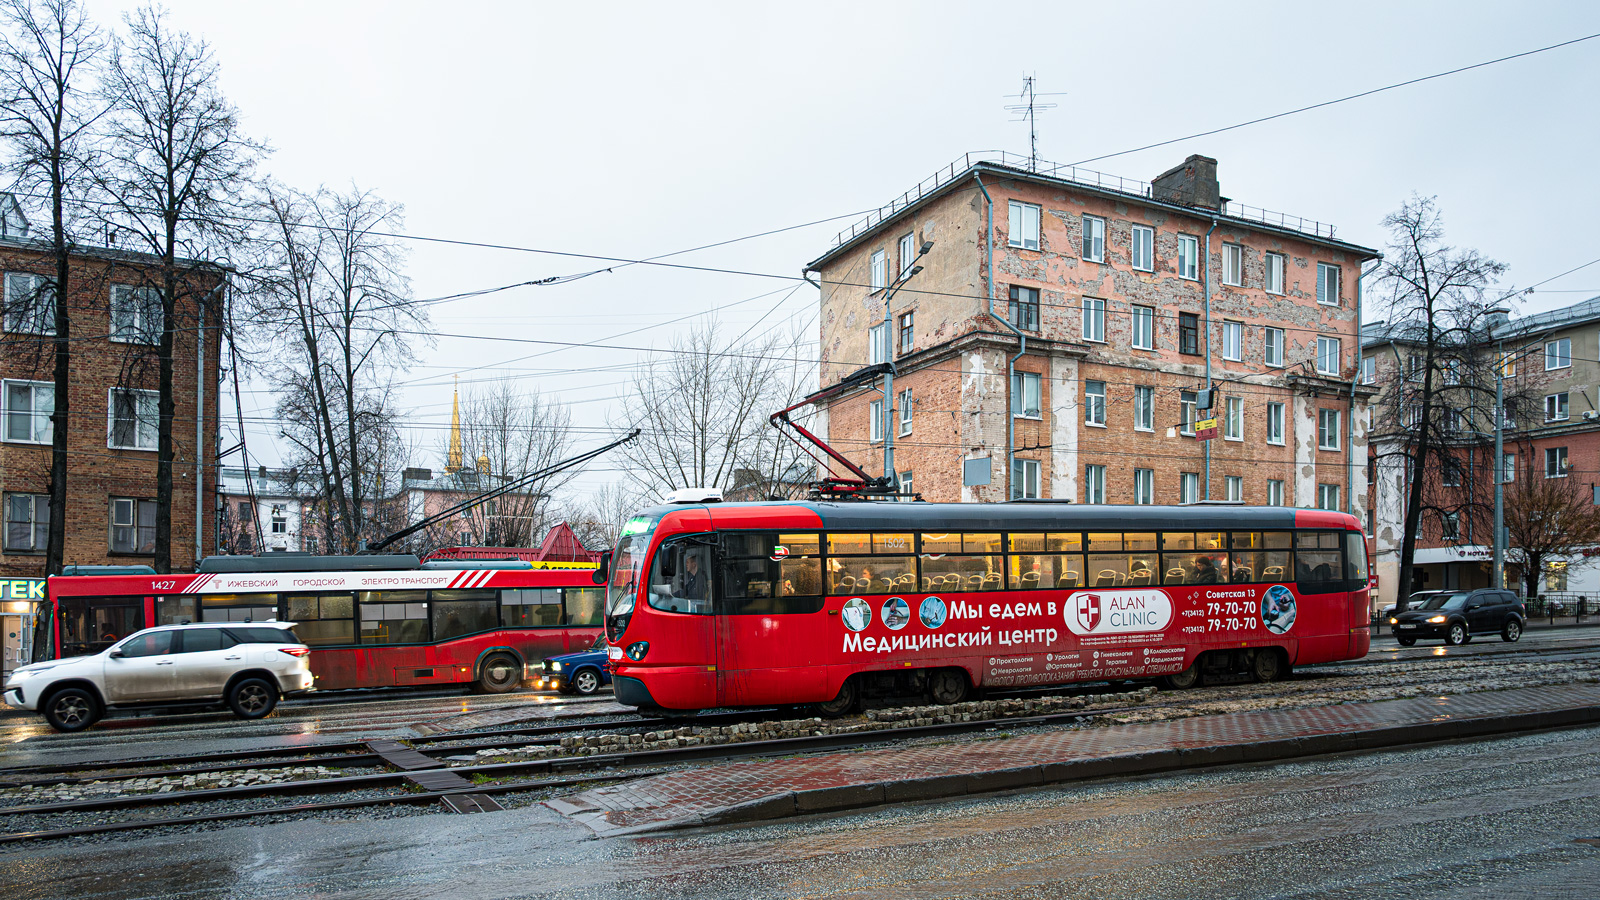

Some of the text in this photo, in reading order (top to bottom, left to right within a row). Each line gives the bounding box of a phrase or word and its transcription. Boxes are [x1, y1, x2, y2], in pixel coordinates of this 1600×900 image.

[883, 538, 905, 549] 1502
[151, 580, 176, 590] 1427
[227, 578, 278, 588] ИЖЕВСКИЙ
[293, 578, 346, 587] ГОРОДСКОЙ
[401, 577, 448, 585] ТРАНСПОРТ
[1206, 589, 1256, 599] Советская 13
[1110, 596, 1145, 610] ALAN
[949, 600, 1057, 620] Мы едем в
[1182, 601, 1256, 618] +7(3412) 79-70-70
[1110, 611, 1157, 626] CLINIC
[1182, 617, 1257, 634] +7(3412) 79-70-70
[842, 626, 1058, 653] Медицинский центр
[996, 657, 1034, 665] Проктология
[1051, 662, 1082, 670] Ортопедия
[984, 663, 1183, 686] ИМЕЮТСЯ ПРОТИВОПОКАЗАНИЯ ТРЕБУЕТСЯ КОНСУЛЬТАЦИЯ СПЕЦИАЛИСТА
[998, 666, 1032, 674] Неврология
